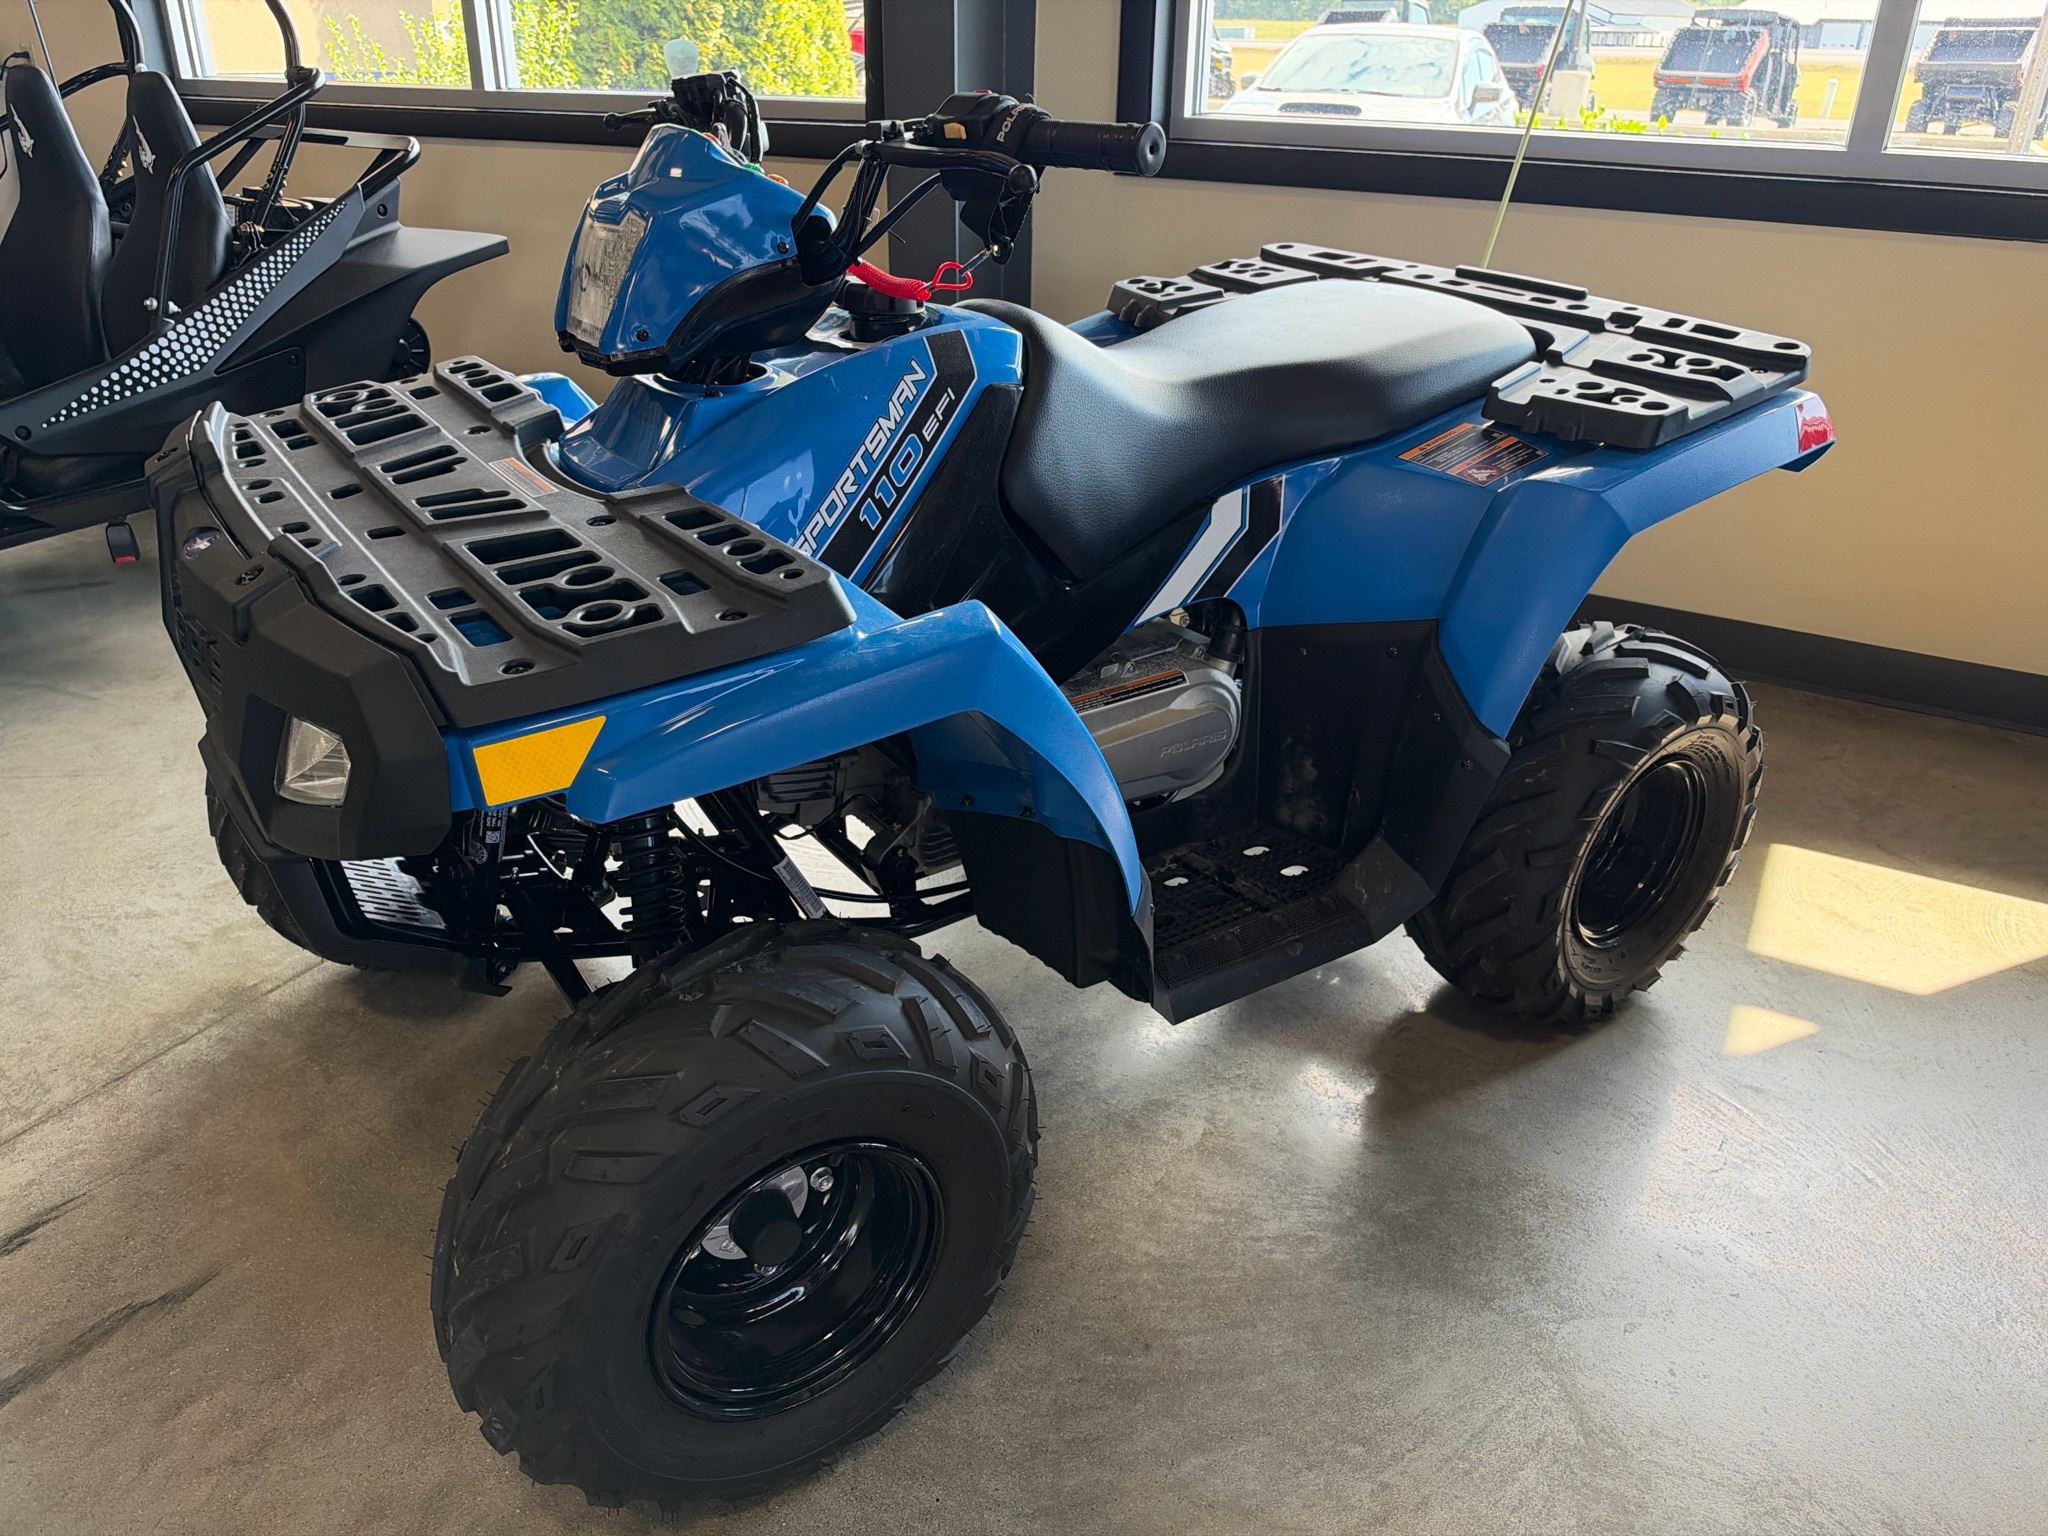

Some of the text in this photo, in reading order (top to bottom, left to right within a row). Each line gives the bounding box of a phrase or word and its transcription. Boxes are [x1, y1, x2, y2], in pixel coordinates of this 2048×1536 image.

[859, 387, 956, 531] 110 EFI
[1160, 729, 1228, 758] POLARIS
